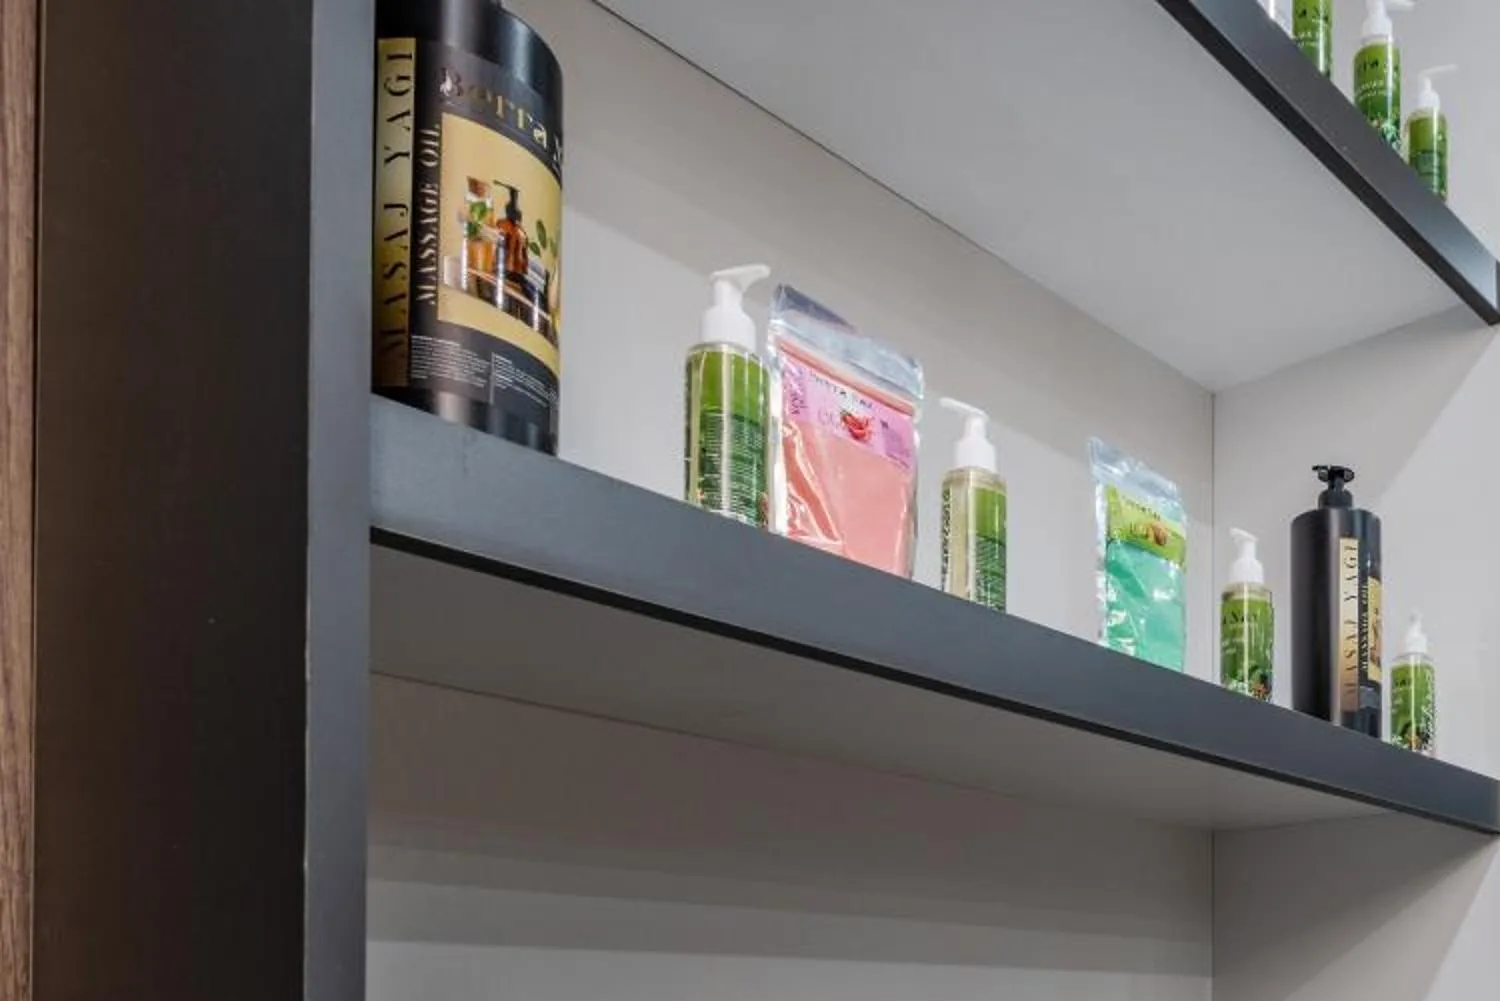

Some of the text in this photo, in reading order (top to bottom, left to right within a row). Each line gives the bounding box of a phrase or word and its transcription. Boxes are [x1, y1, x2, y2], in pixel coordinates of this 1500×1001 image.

[378, 203, 408, 358] MASAJ
[417, 123, 441, 306] MASSAGE OIL
